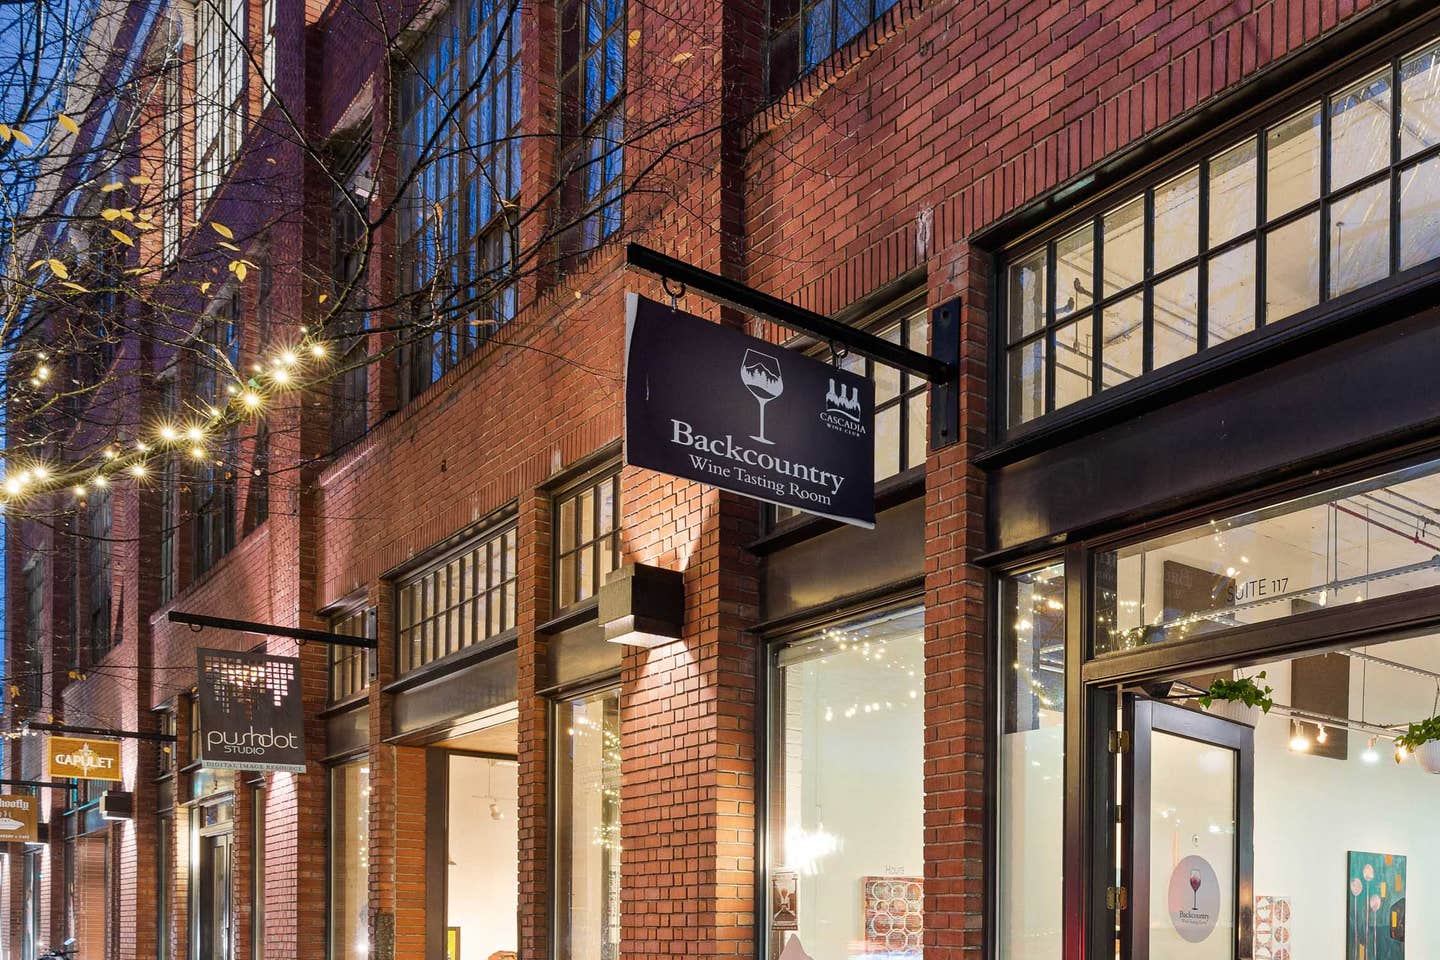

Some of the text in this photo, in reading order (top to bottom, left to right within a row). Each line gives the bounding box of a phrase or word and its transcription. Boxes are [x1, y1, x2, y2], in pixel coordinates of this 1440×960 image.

[820, 412, 866, 434] CASCADIA
[826, 423, 860, 437] WINE CLUB
[670, 418, 846, 495] Backcountry
[688, 454, 832, 506] Wine Tasting Room
[1227, 577, 1289, 602] SUITE 117
[207, 725, 299, 752] pushdot
[224, 745, 265, 755] STUDIO
[55, 754, 115, 769] CAPULET
